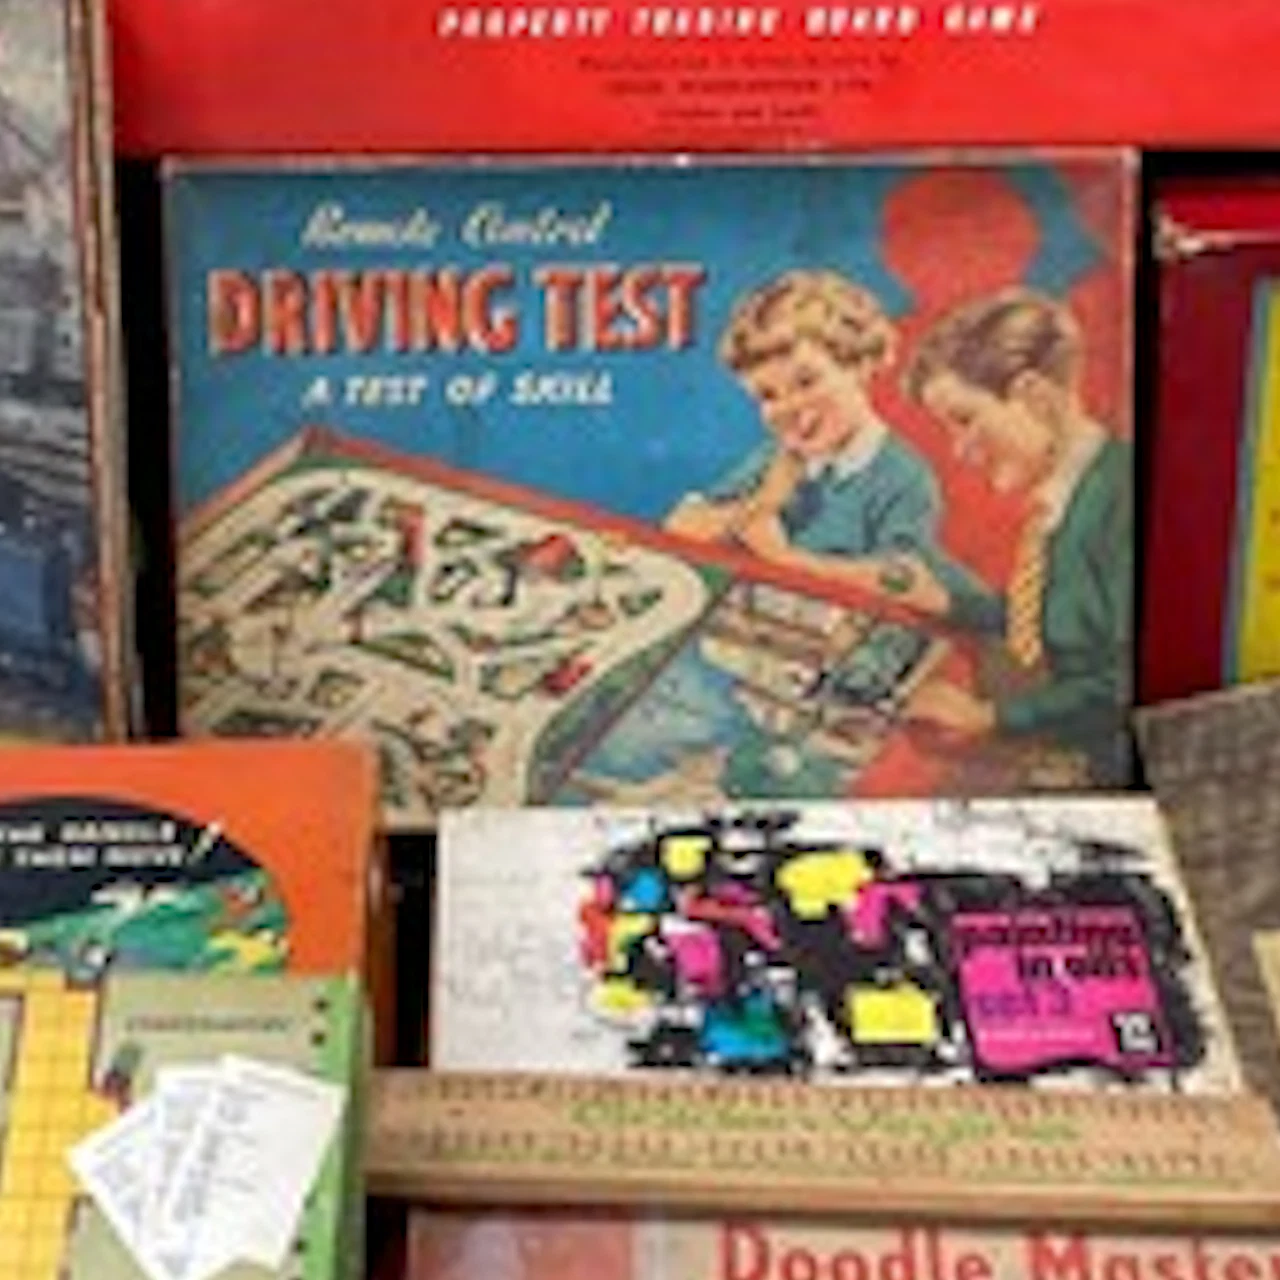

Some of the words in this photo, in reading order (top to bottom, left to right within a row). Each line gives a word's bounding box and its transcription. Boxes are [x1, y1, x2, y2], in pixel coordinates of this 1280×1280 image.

[436, 4, 615, 37] PROPERTY
[630, 4, 782, 37] TRADING
[805, 3, 920, 36] BOARD
[942, 1, 1044, 36] GAME
[302, 202, 436, 251] Remote
[463, 202, 612, 250] Control
[206, 269, 520, 360] DRIVING
[533, 263, 706, 354] TEST
[343, 376, 427, 409] TEST
[511, 373, 614, 408] SKILL
